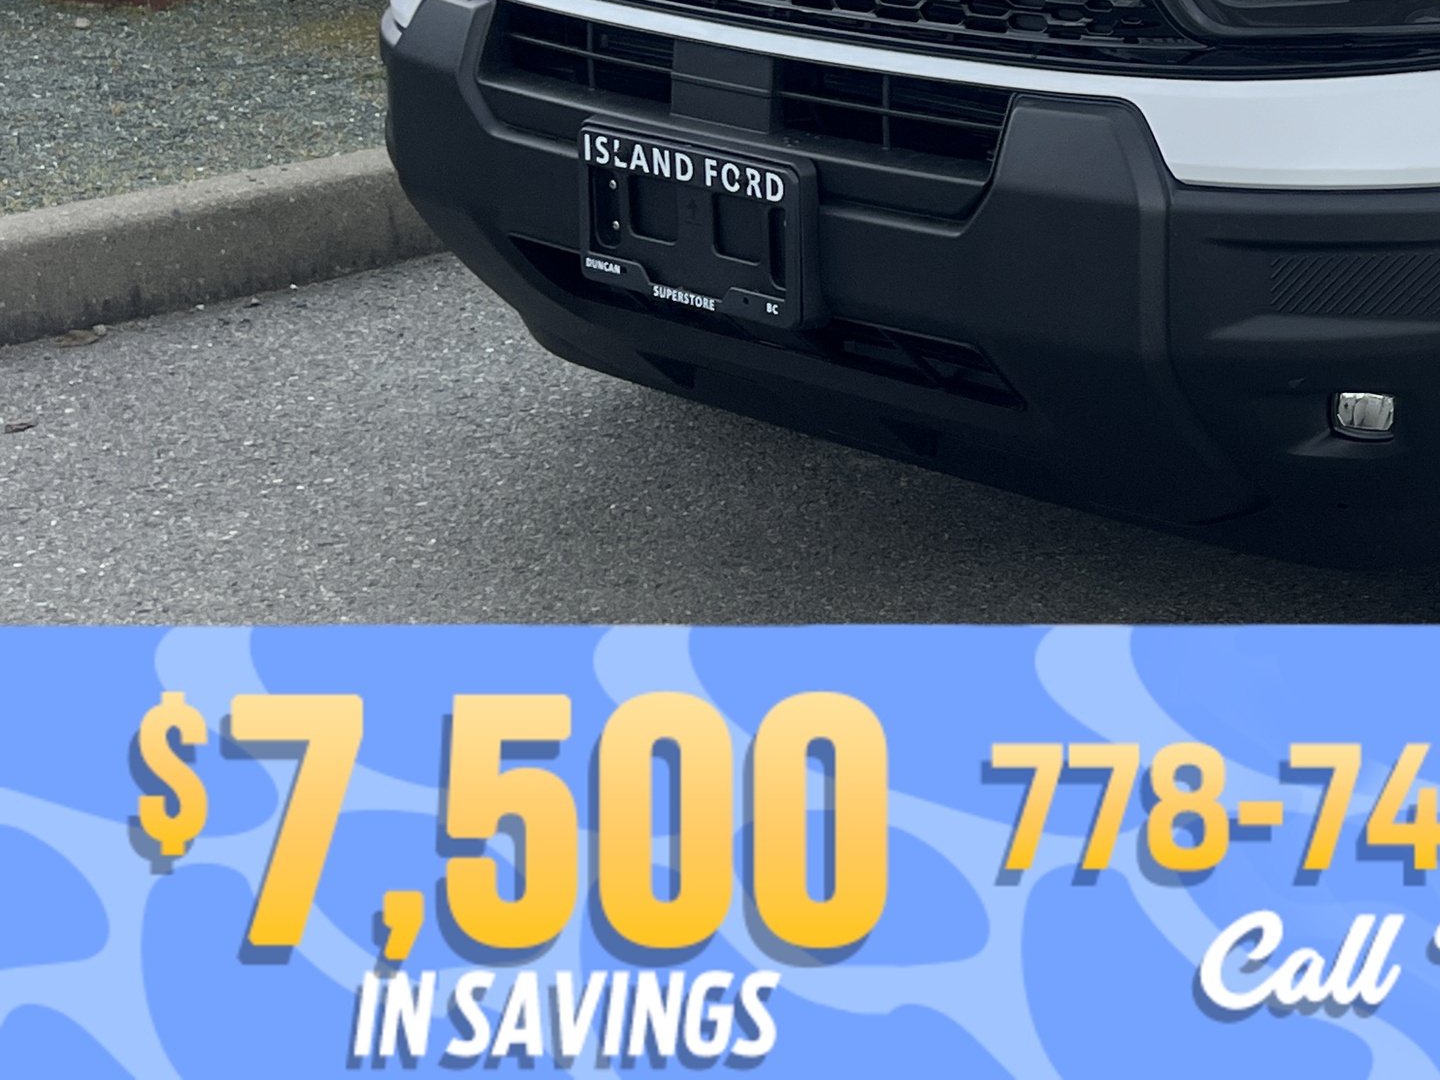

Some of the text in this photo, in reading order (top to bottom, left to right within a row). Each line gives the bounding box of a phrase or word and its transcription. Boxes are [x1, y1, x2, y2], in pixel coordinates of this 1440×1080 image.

[584, 133, 785, 202] ISLAND FORD
[585, 256, 622, 275] DUNCAN
[653, 285, 780, 315] SUPERSTORE BC
